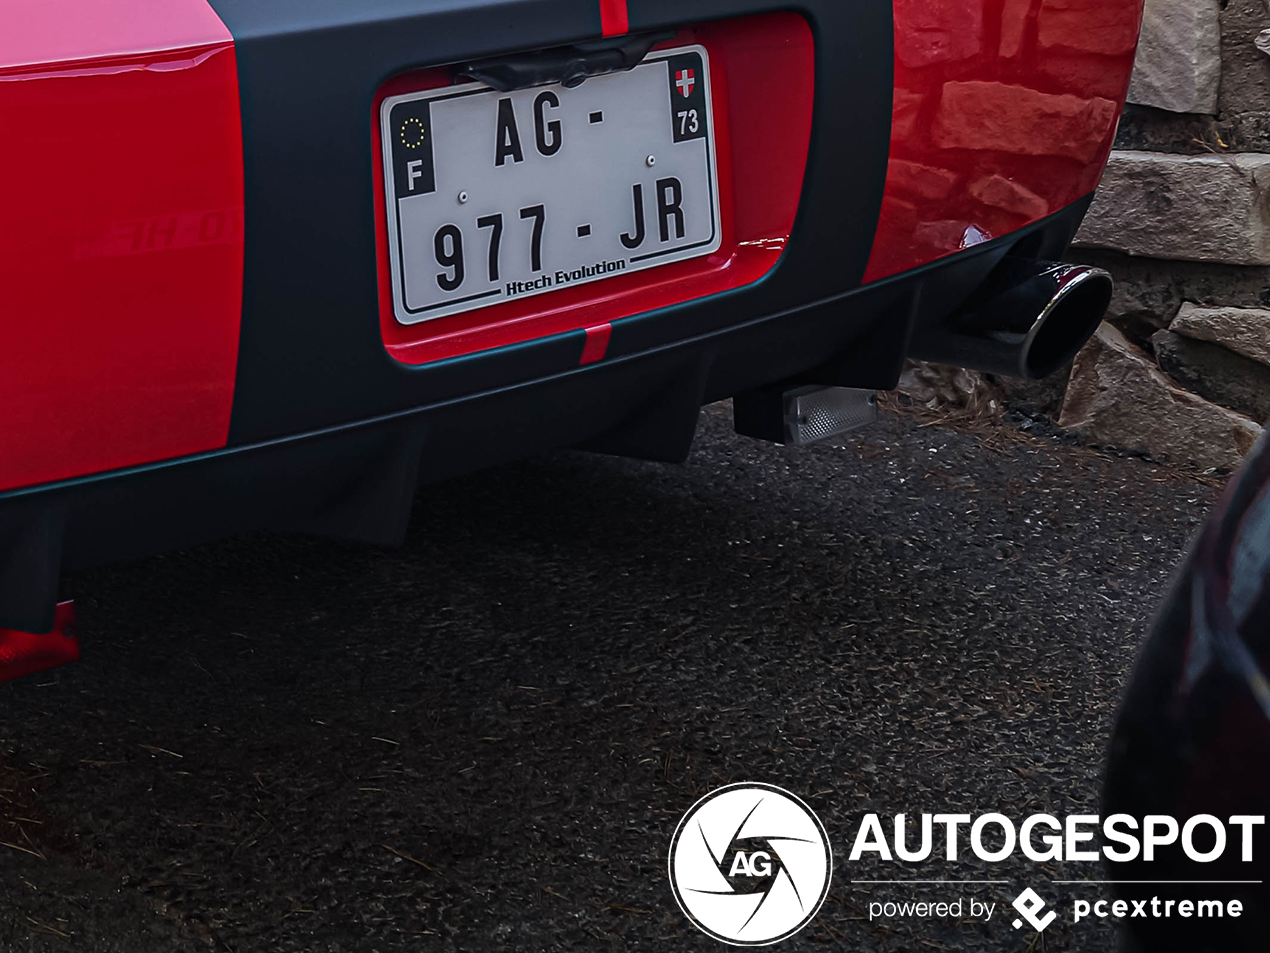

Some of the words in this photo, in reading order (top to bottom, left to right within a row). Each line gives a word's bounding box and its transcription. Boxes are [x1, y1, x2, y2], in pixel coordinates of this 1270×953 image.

[677, 109, 699, 135] 73
[407, 159, 423, 191] F
[505, 274, 552, 296] Htech
[555, 258, 626, 283] Evolution
